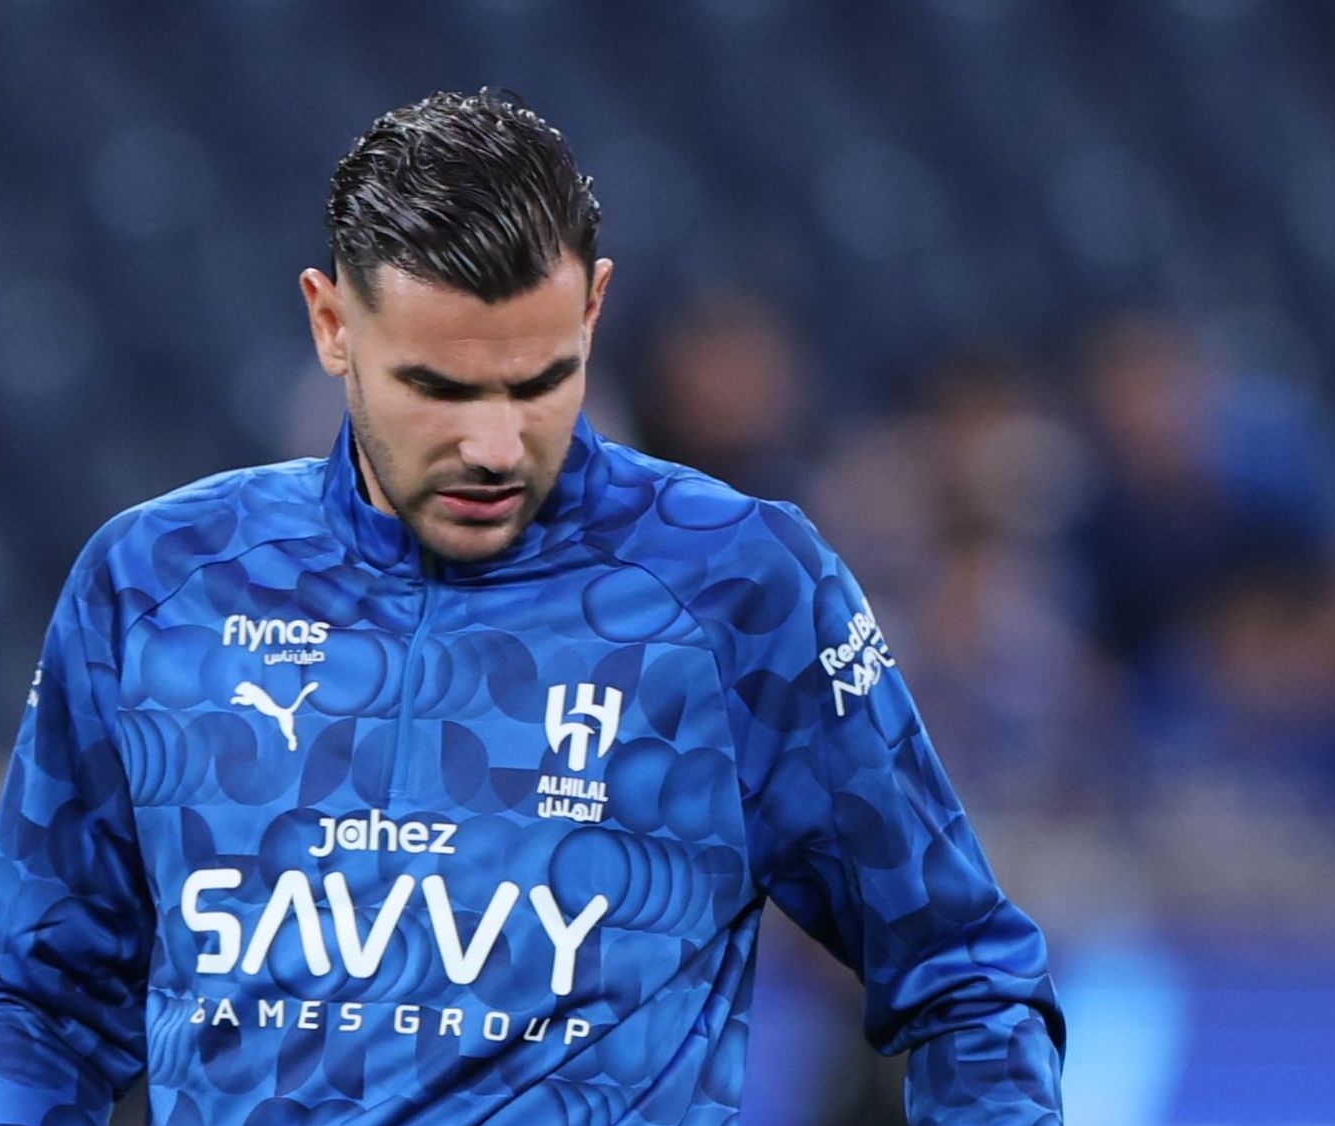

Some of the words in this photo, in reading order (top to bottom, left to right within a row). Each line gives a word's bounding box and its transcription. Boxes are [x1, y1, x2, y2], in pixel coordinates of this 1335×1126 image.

[223, 614, 330, 652] flynas
[537, 775, 609, 802] ALHILAL
[537, 796, 604, 822] الهلال
[309, 808, 457, 857] jahez
[181, 868, 608, 995] SAVVY
[394, 1004, 590, 1045] GROUP
